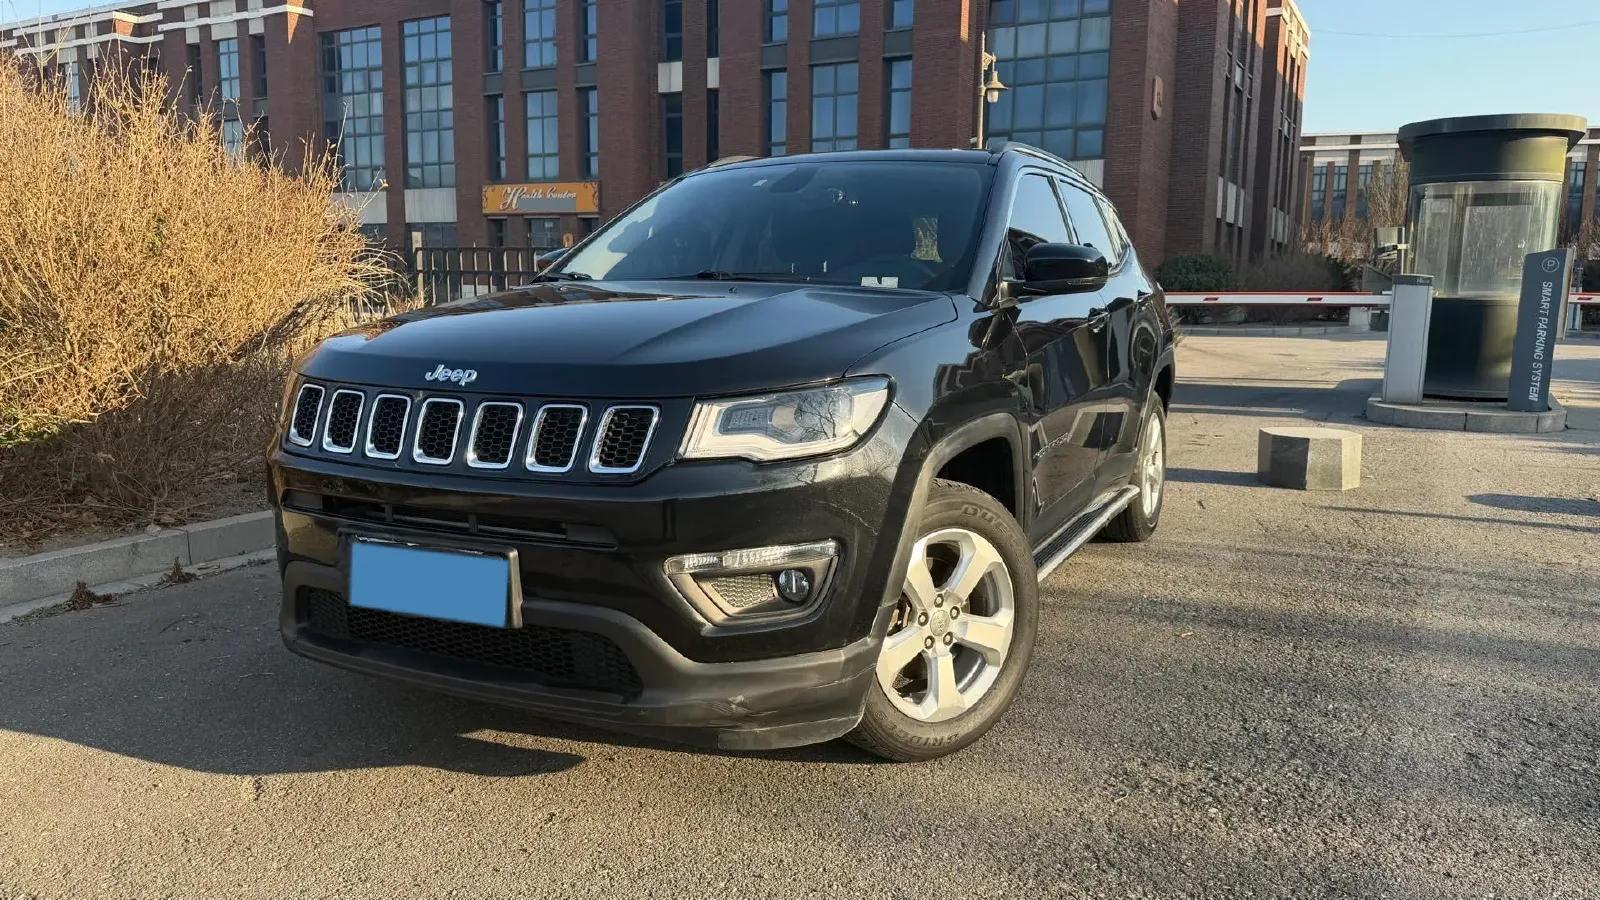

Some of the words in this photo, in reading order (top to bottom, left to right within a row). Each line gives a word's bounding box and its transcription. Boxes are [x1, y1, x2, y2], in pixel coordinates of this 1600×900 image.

[1539, 281, 1553, 316] SMART
[1533, 317, 1548, 361] PARKING
[425, 364, 478, 386] Jeep
[1528, 362, 1543, 402] SYSTEM
